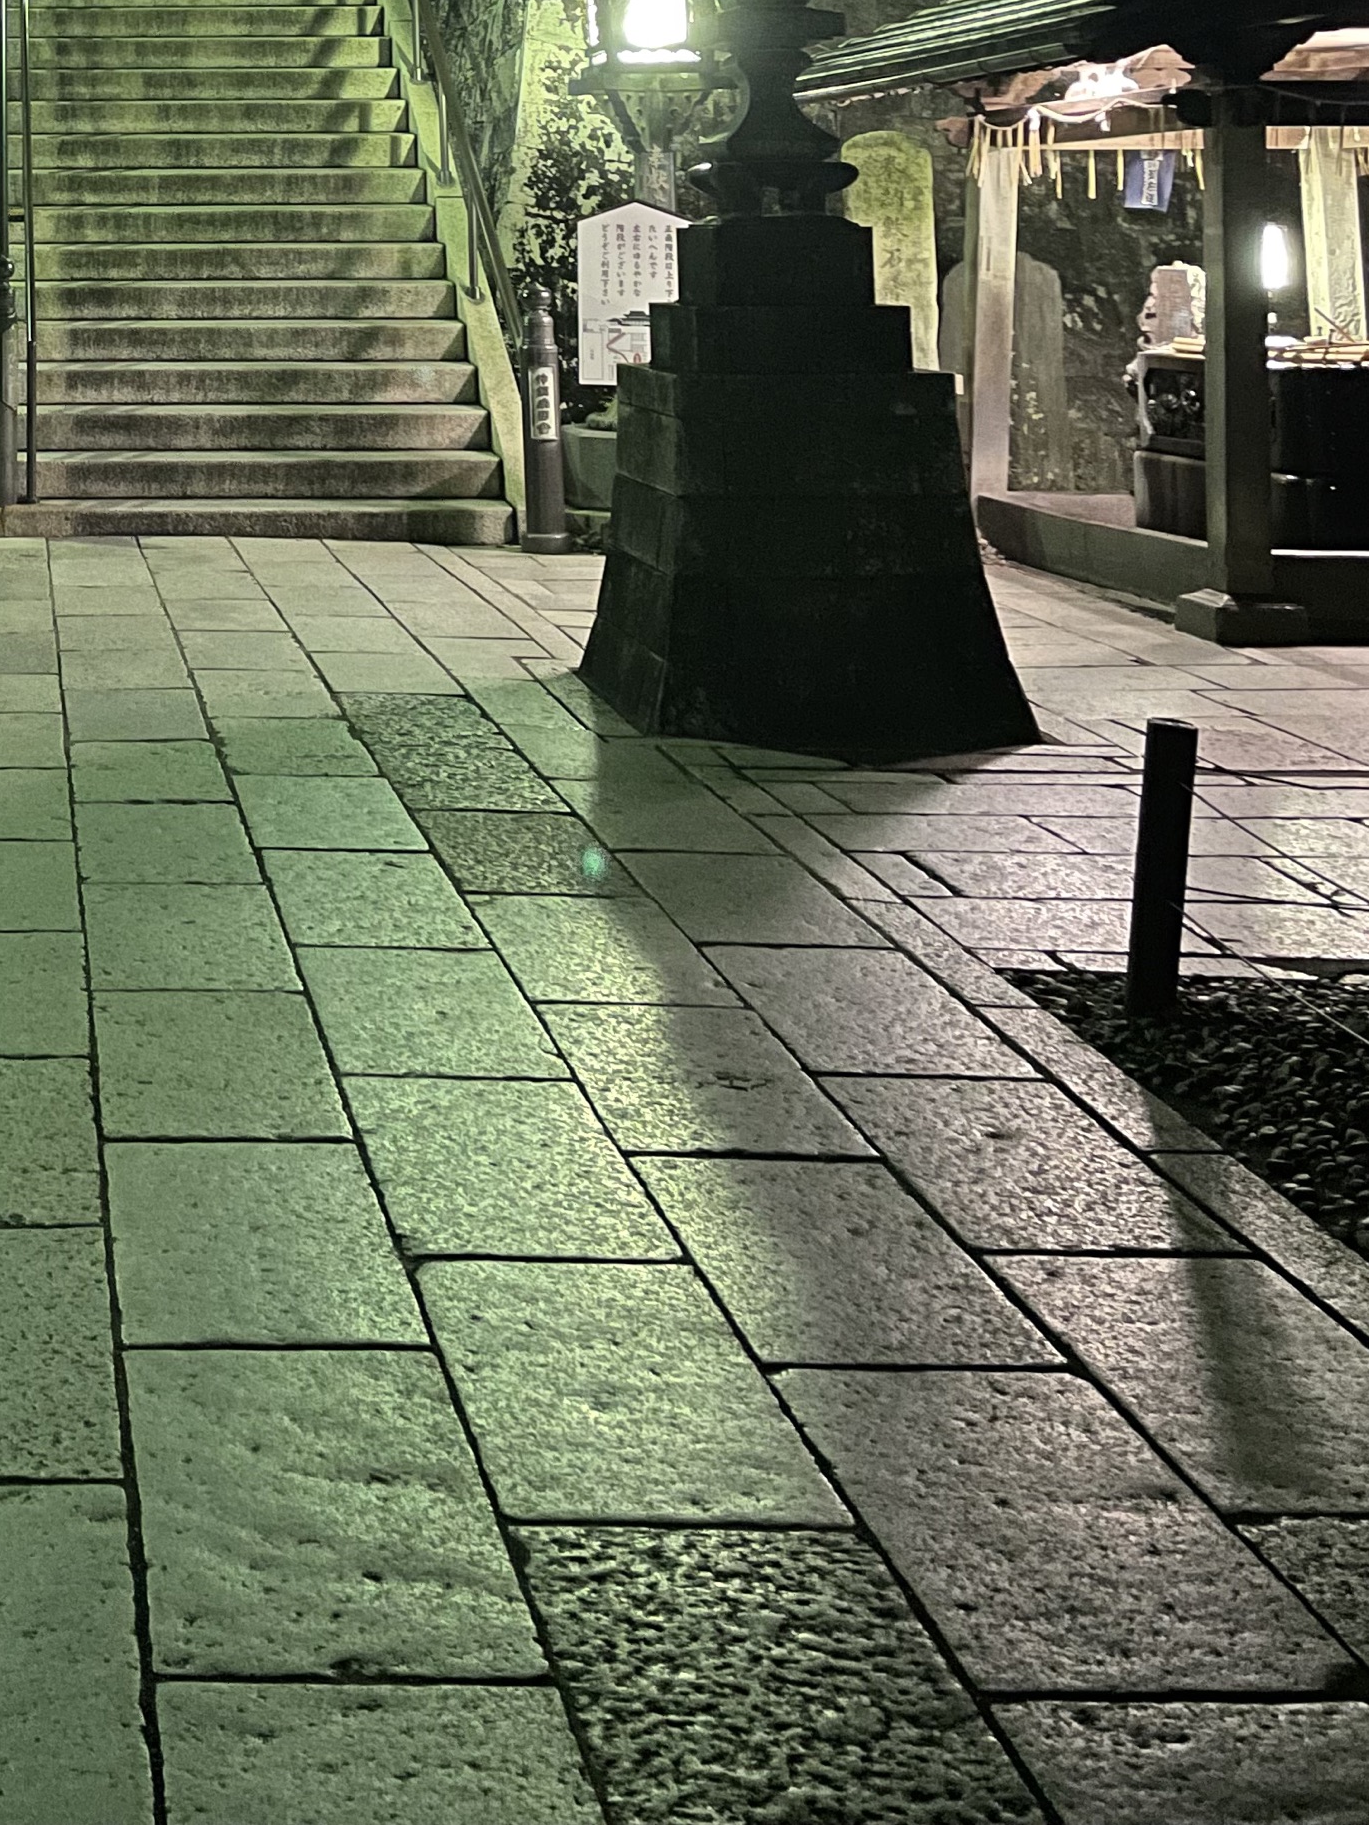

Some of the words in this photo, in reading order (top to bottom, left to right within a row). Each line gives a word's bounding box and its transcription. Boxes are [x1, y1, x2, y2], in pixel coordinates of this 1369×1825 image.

[600, 224, 610, 305] どうぞご利用下さい
[616, 224, 626, 297] 階段がございます
[632, 224, 642, 297] 左右にゆるやかな
[648, 225, 658, 279] たいへんです
[664, 225, 674, 302] 正面階段は上り下
